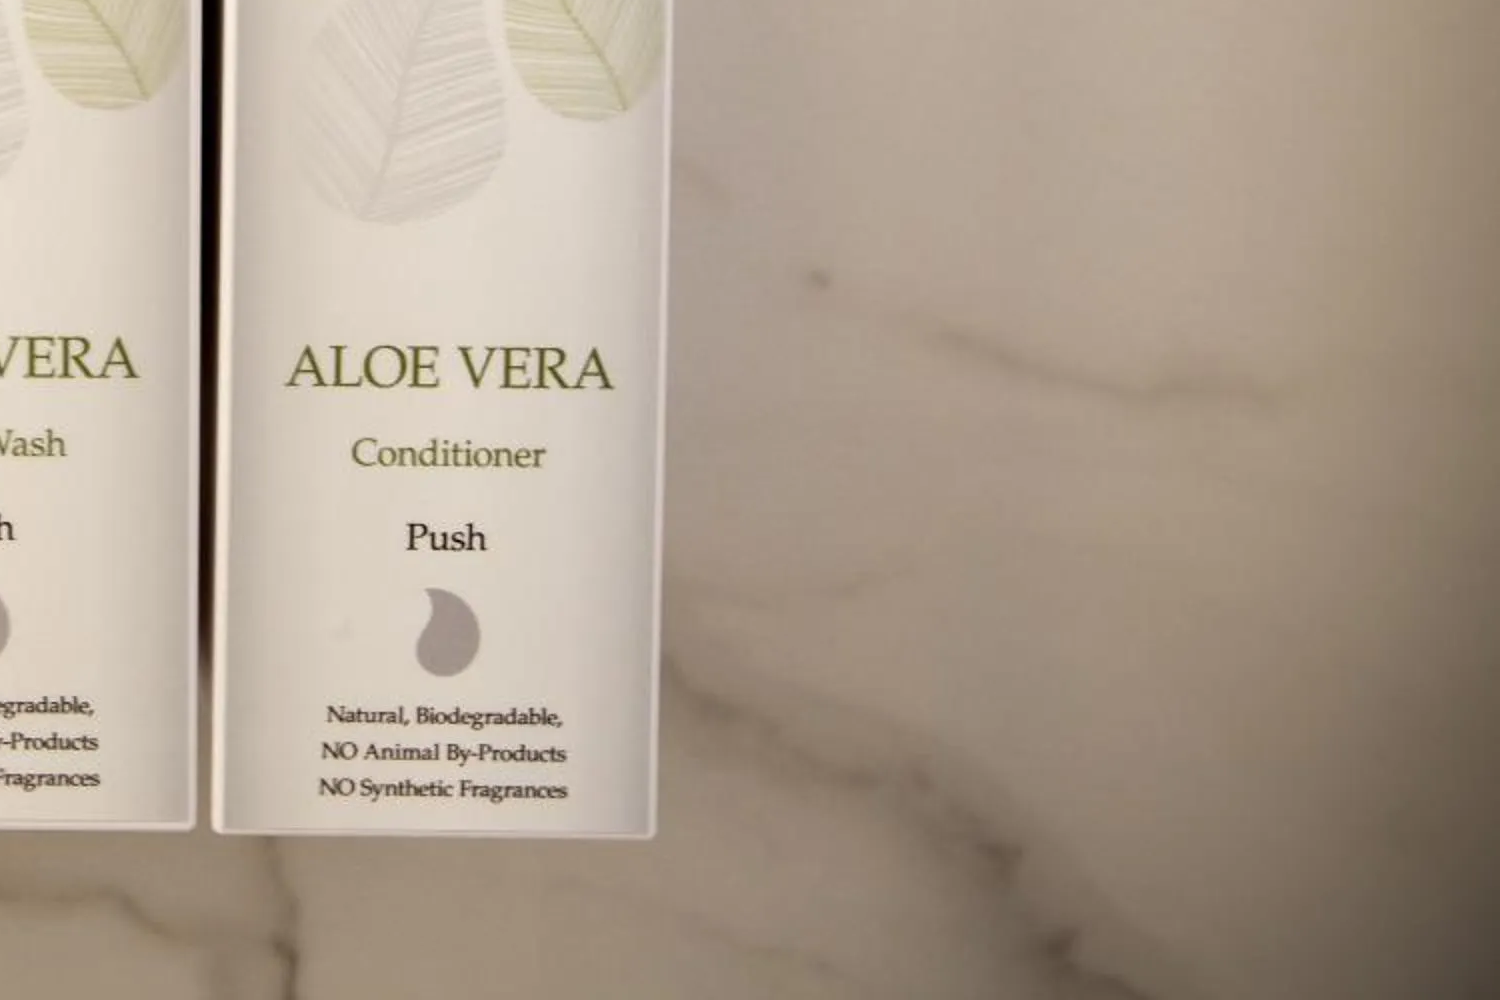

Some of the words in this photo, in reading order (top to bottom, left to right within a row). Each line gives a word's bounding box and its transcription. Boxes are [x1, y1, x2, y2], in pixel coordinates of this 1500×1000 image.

[285, 345, 439, 389] ALOE
[458, 346, 614, 391] VERA
[351, 438, 546, 468] Conditioner
[406, 523, 487, 551] Push
[327, 706, 410, 728] Natural,
[416, 707, 563, 730] Biodegradable,
[322, 742, 358, 760] NO
[364, 743, 439, 761] Animal
[446, 743, 567, 767] By-Products
[319, 778, 355, 797] NO
[359, 778, 454, 801] Synthetic
[459, 780, 568, 803] Fragrances
